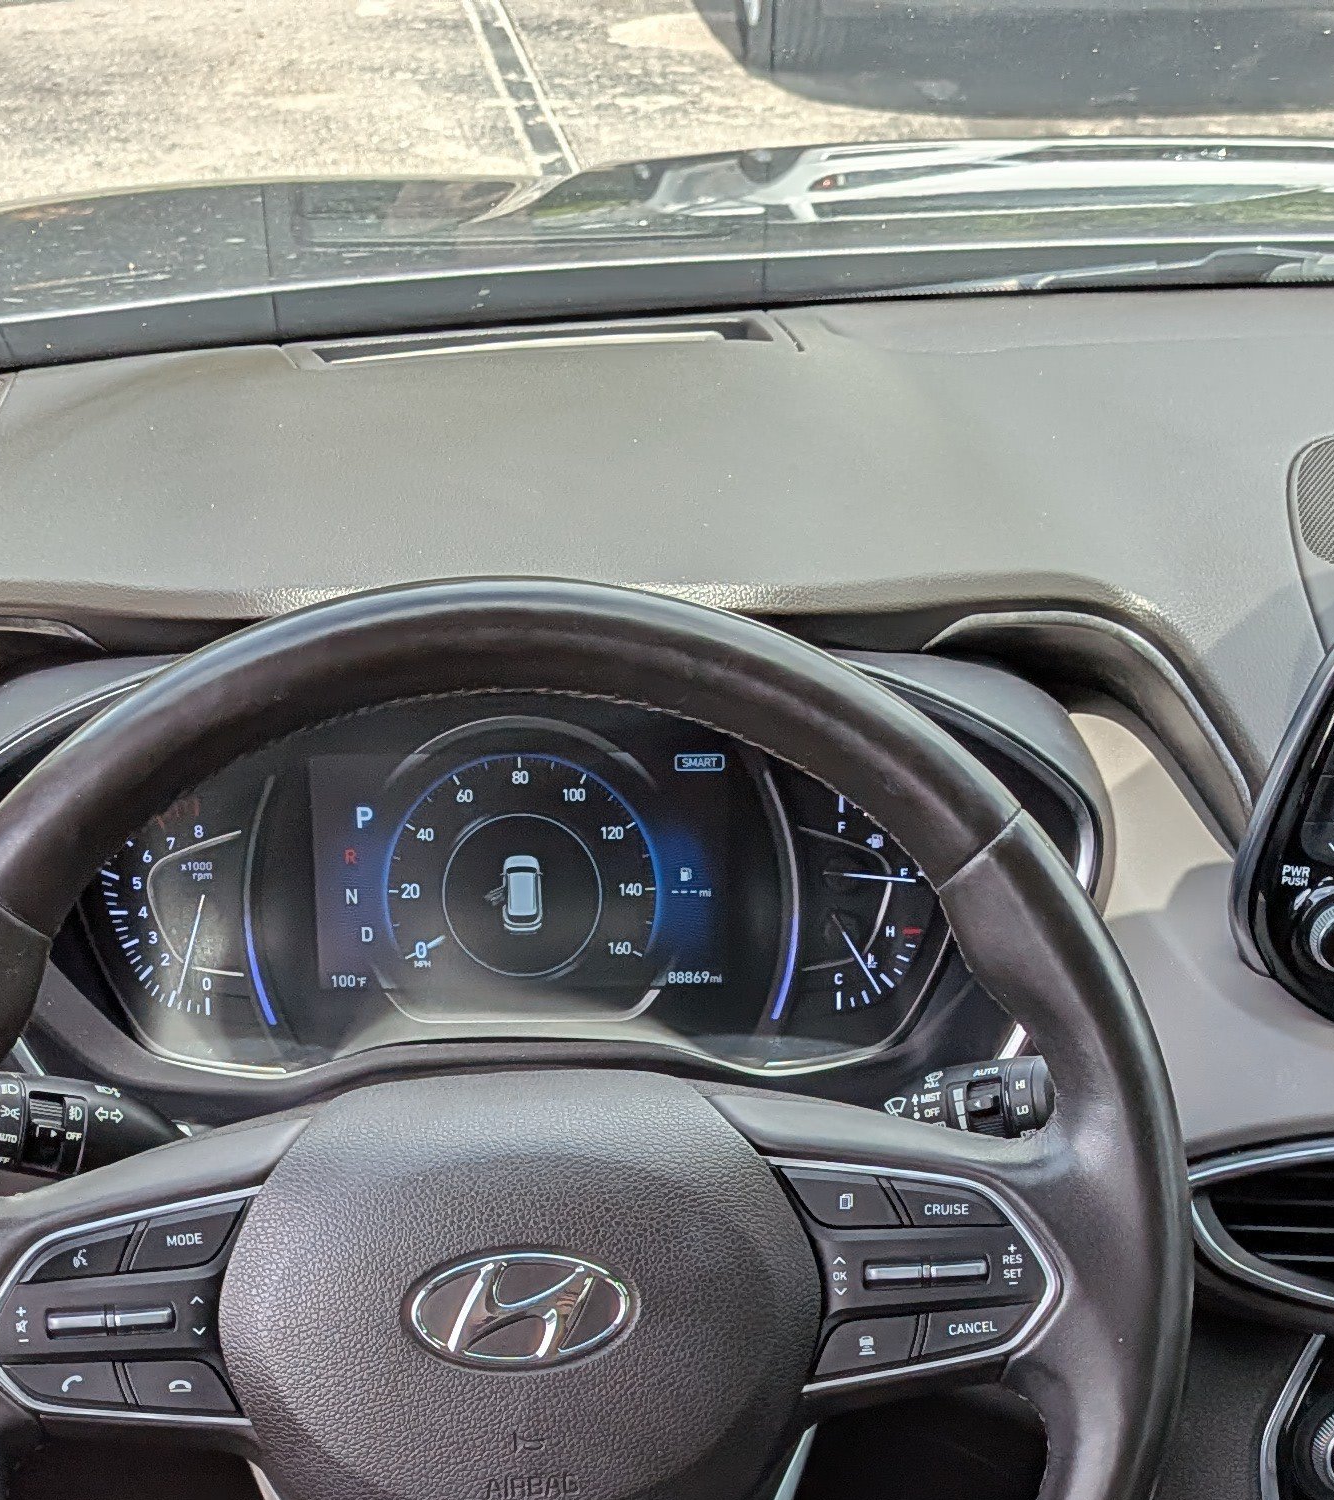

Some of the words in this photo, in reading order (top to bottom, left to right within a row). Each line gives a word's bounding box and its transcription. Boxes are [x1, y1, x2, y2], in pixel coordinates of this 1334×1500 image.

[681, 756, 718, 770] SMART
[511, 770, 529, 785] 80
[456, 789, 474, 804] 60
[562, 788, 587, 803] 100
[355, 806, 373, 829] P
[193, 824, 205, 839] 8
[416, 827, 435, 842] 40
[600, 826, 624, 840] 120
[837, 822, 847, 834] F
[165, 836, 176, 851] 7
[142, 850, 153, 864] 6
[344, 849, 357, 865] R
[180, 861, 213, 872] x1000
[1281, 865, 1311, 878] PWR
[132, 877, 142, 891] 5
[192, 872, 213, 882] rpm
[1281, 875, 1309, 887] PUSH
[344, 888, 359, 905] N
[400, 884, 421, 900] 20
[618, 883, 643, 897] 140
[137, 906, 148, 919] 4
[148, 931, 158, 945] 3
[361, 926, 374, 943] D
[886, 925, 896, 938] H
[607, 942, 632, 956] 160
[160, 953, 170, 967] 2
[202, 977, 212, 991] 0
[834, 973, 844, 986] C
[972, 1066, 999, 1077] AUTO
[923, 1106, 941, 1118] OFF
[1016, 1104, 1030, 1116] LO
[64, 1131, 83, 1142] OFF
[923, 1203, 970, 1217] CRUISE
[166, 1231, 204, 1247] MODE
[1002, 1253, 1023, 1266] RES
[832, 1271, 848, 1283] OK
[1002, 1268, 1023, 1280] SET
[948, 1320, 998, 1337] CANCEL
[484, 1473, 582, 1500] AIRBAG
